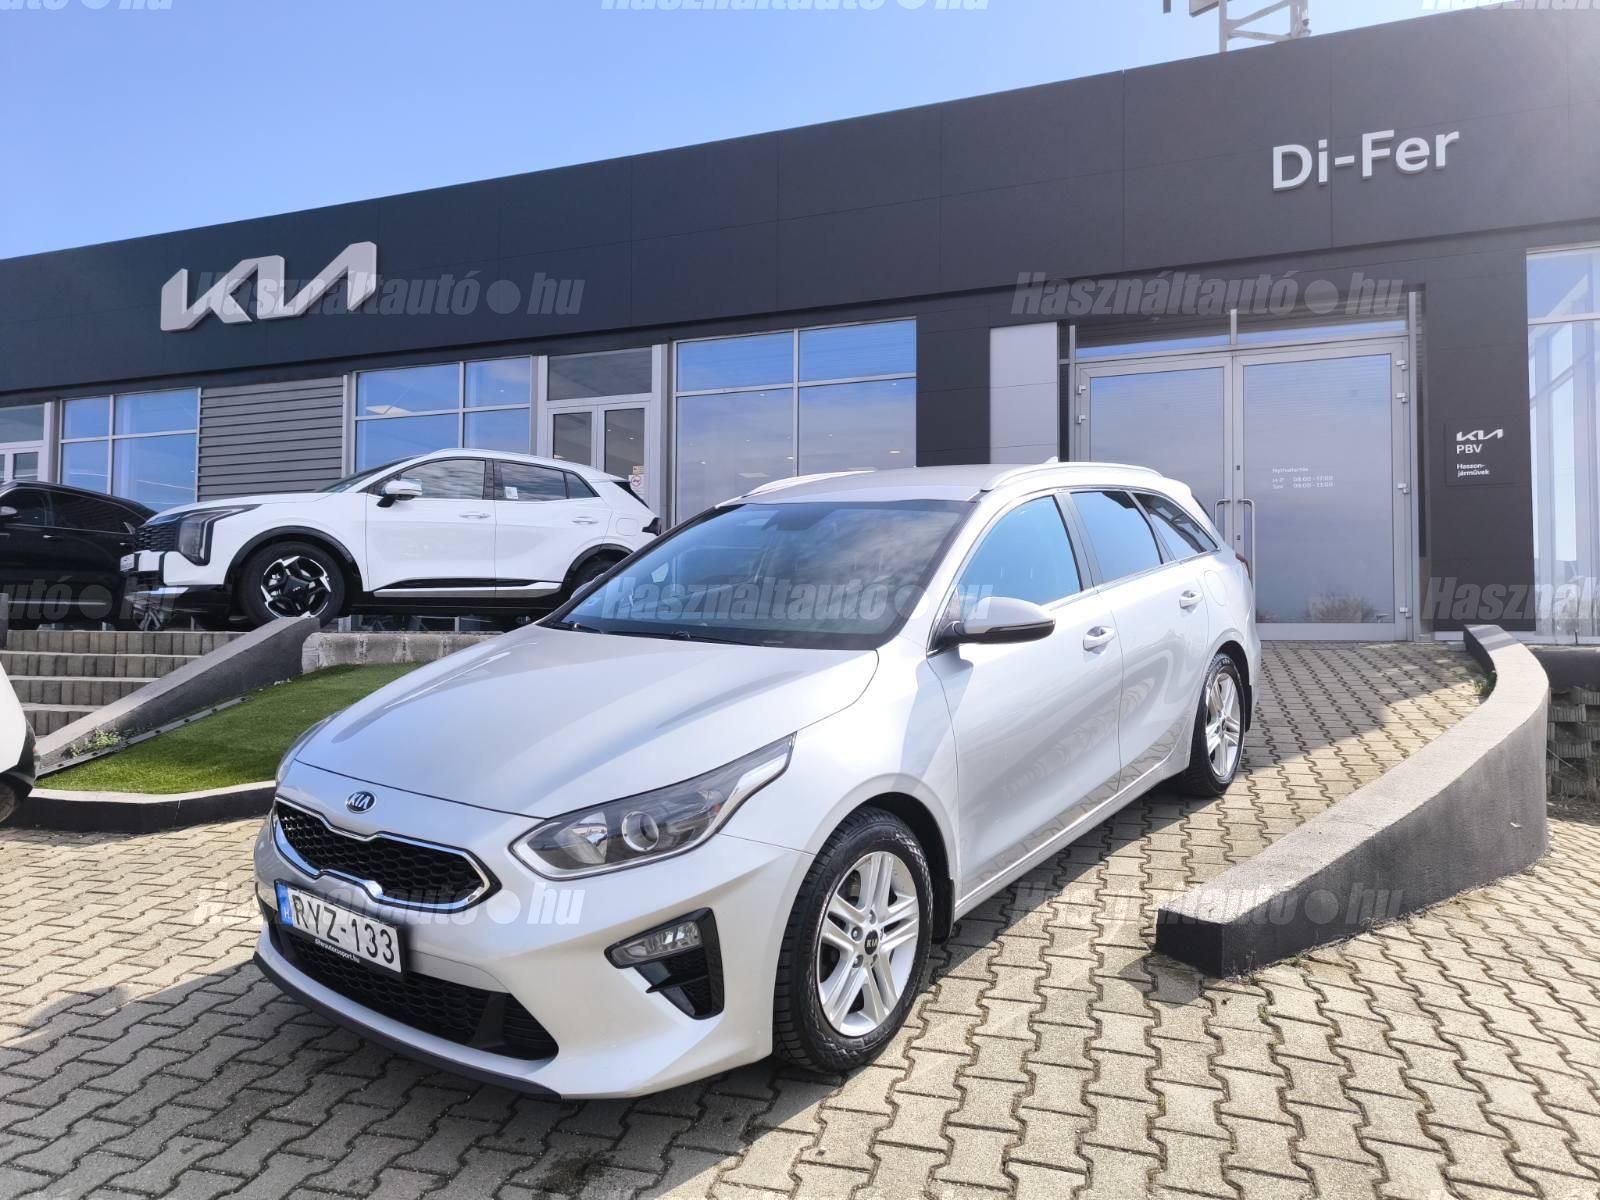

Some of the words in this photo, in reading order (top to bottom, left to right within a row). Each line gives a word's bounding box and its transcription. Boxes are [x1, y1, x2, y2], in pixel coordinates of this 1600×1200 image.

[1272, 130, 1460, 192] Di-Fer
[160, 241, 377, 332] KIA
[1456, 429, 1503, 441] KIA
[1456, 444, 1482, 454] PBV
[347, 793, 371, 809] KIA
[292, 894, 395, 965] RYZ-133
